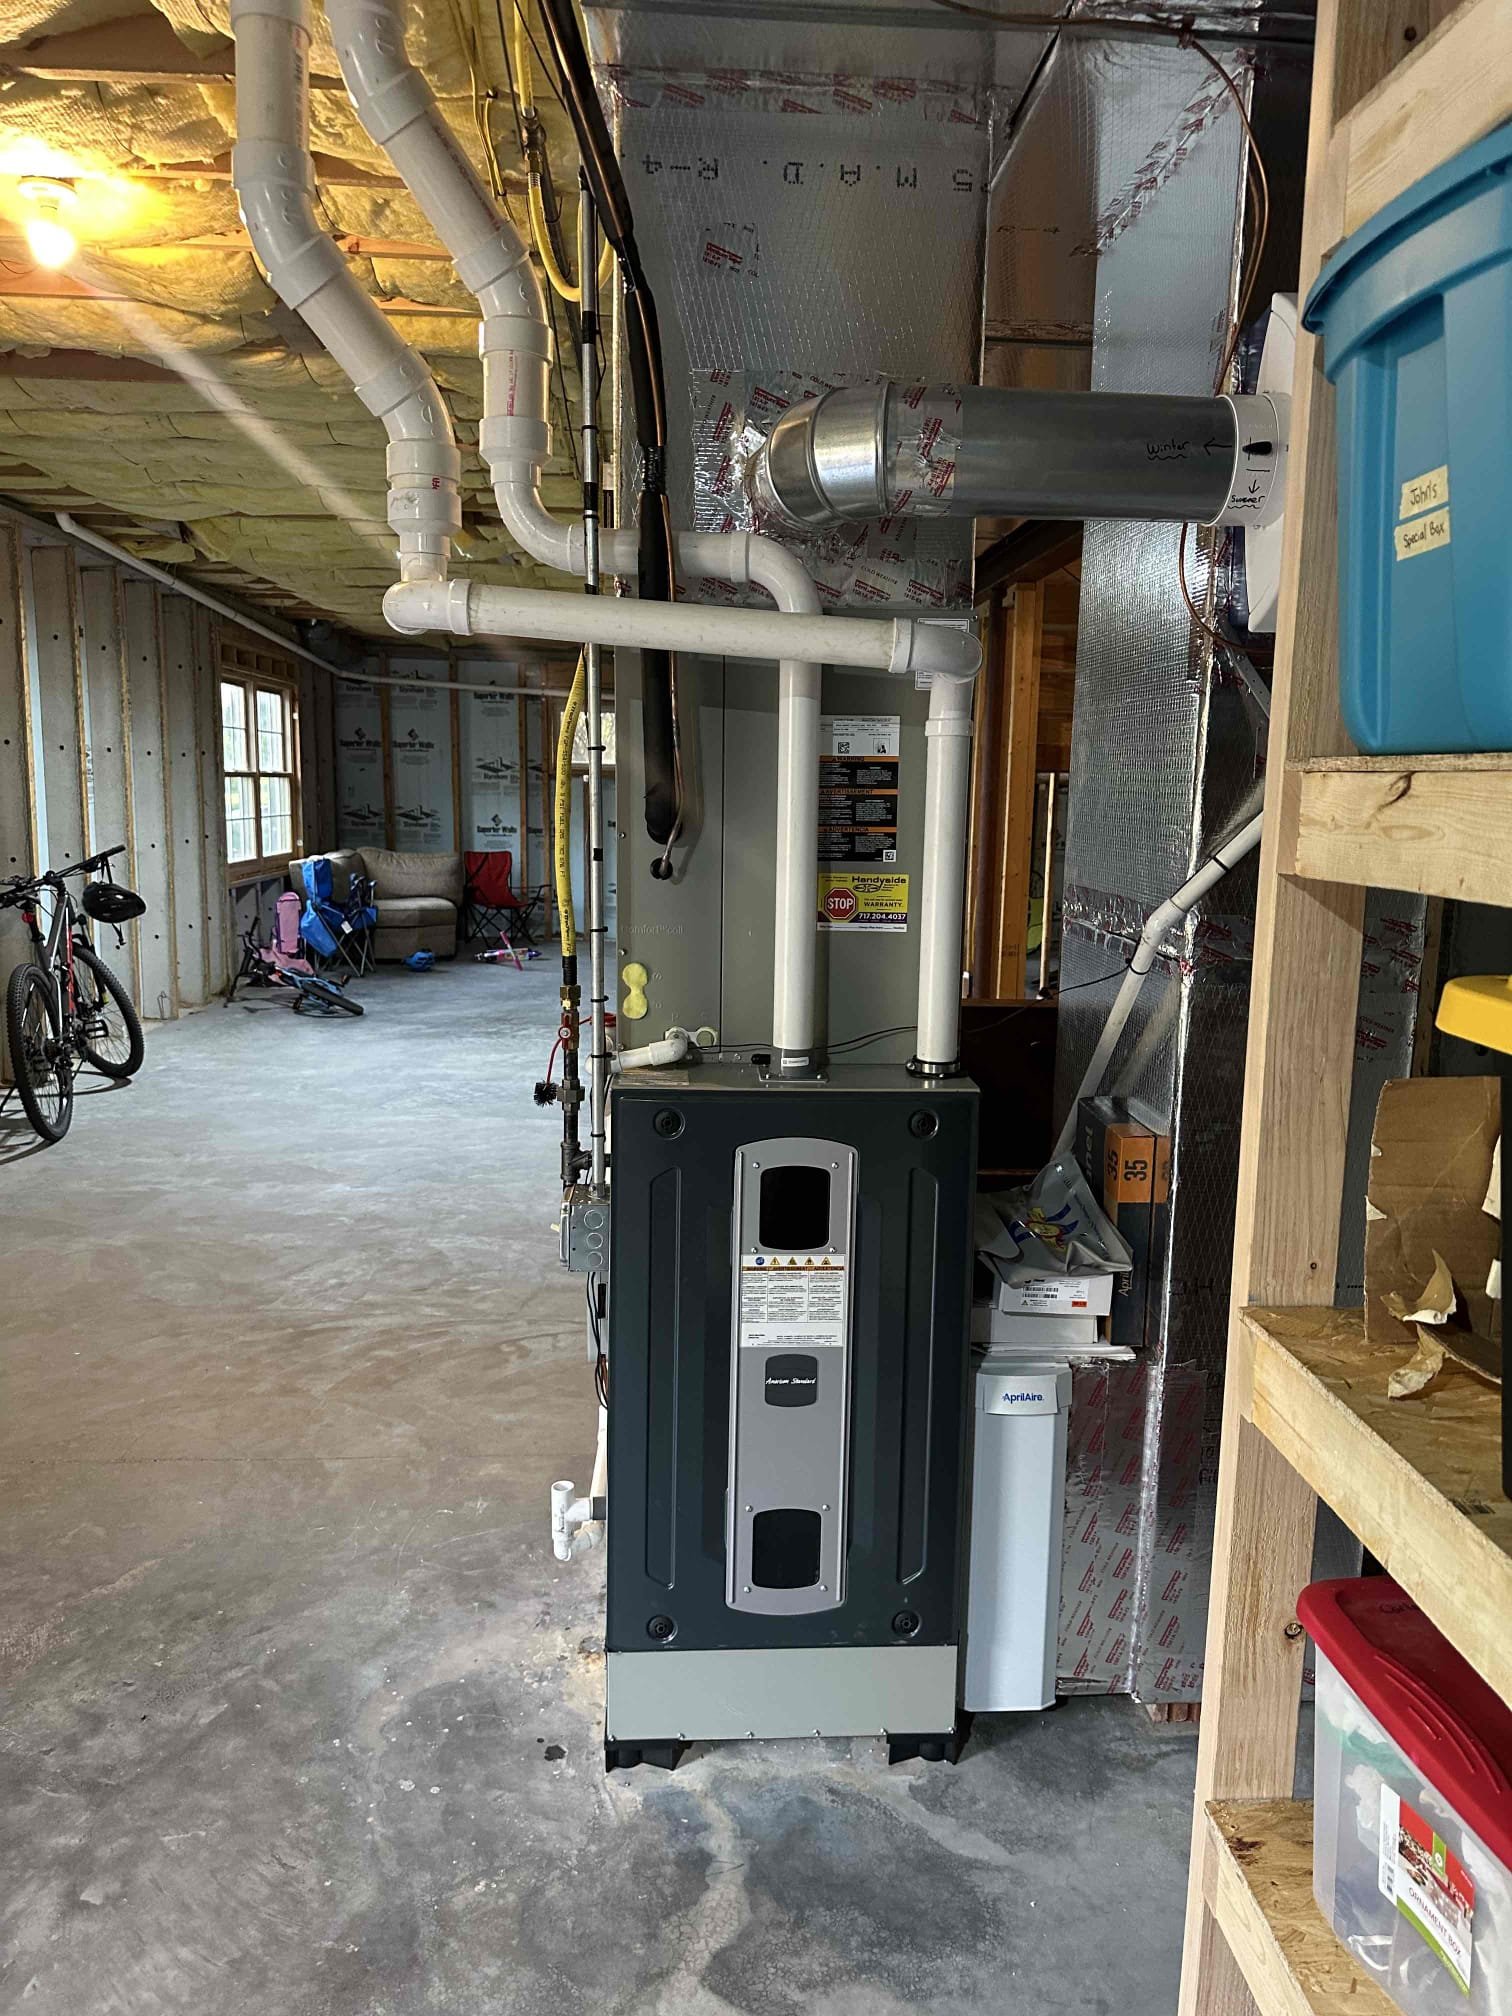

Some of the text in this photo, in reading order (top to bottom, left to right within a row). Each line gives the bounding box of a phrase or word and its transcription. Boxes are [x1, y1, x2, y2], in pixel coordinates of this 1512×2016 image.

[1147, 437, 1190, 455] Winter
[1409, 480, 1437, 506] John's
[1403, 521, 1445, 549] Special Box
[852, 876, 907, 888] Handyside
[827, 897, 854, 910] STOP
[858, 912, 906, 920] 717.204.4037
[1106, 1149, 1119, 1181] 35
[1123, 1159, 1148, 1182] 35
[1003, 1393, 1043, 1404] AprilAire
[1408, 1887, 1448, 1939] ORNAMENT
[1448, 1933, 1462, 1955] BOX
